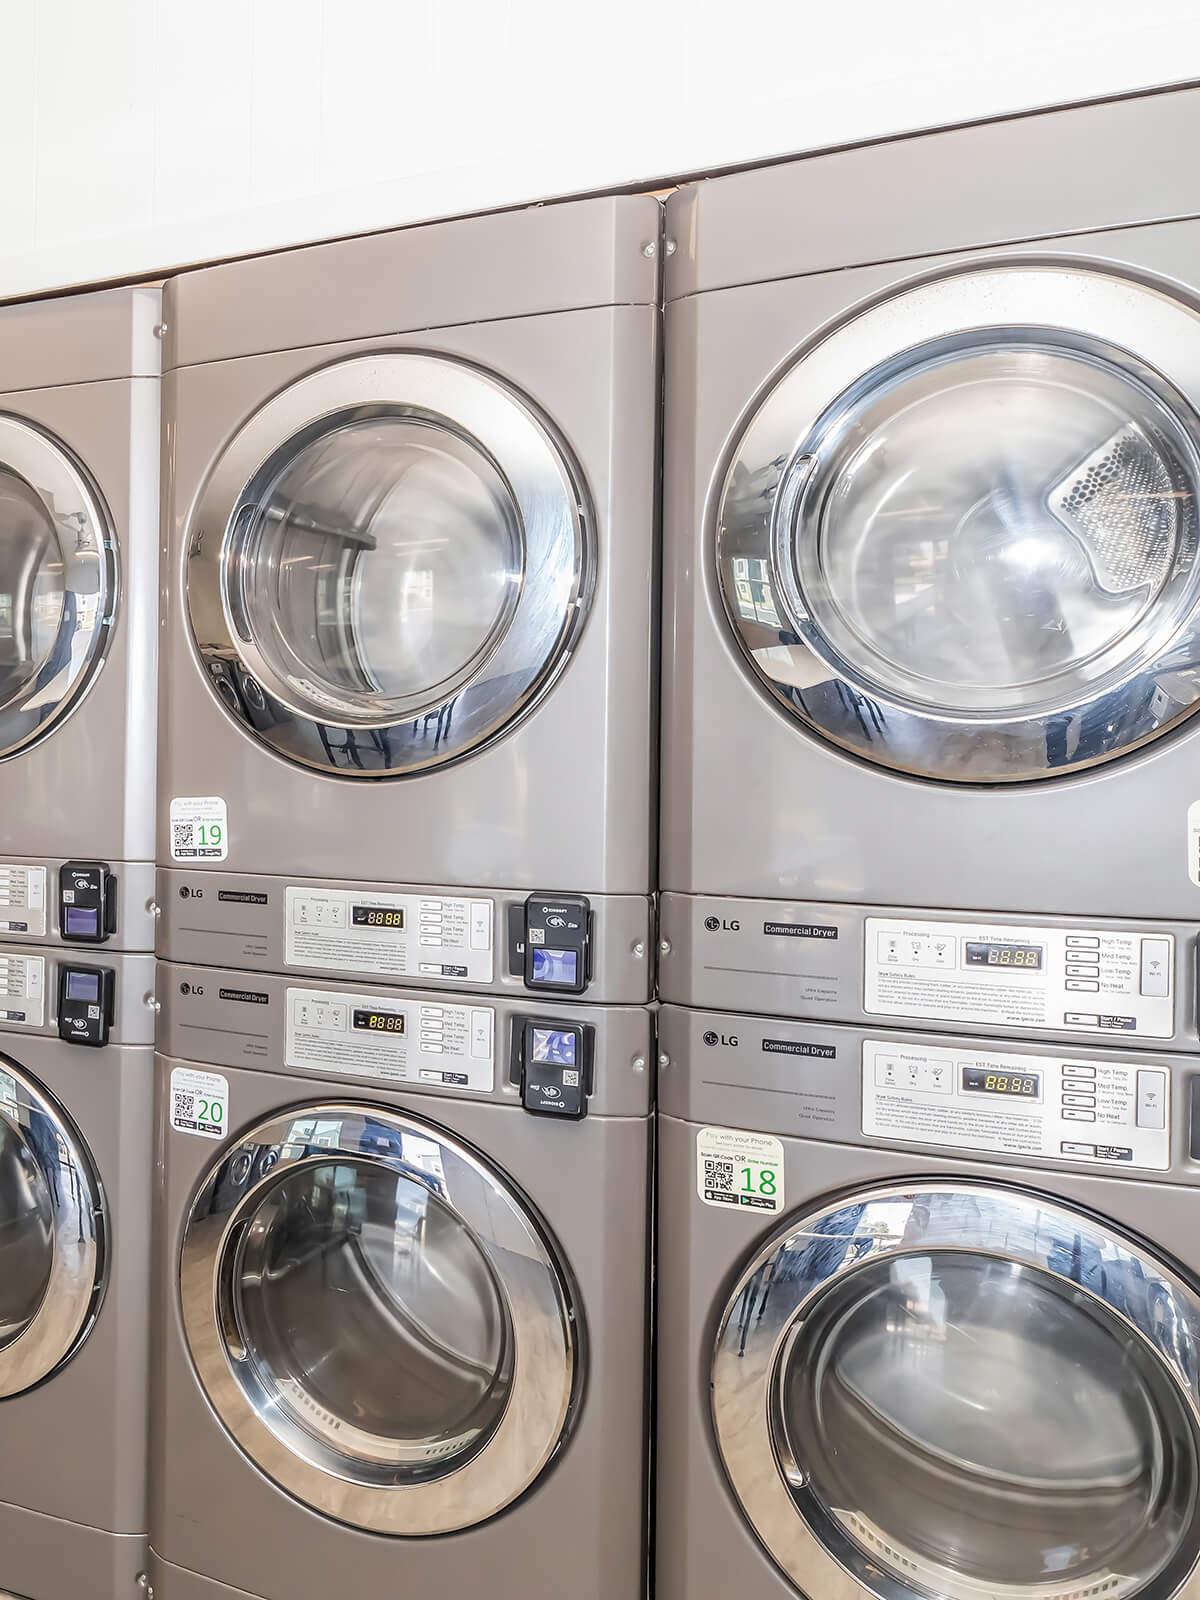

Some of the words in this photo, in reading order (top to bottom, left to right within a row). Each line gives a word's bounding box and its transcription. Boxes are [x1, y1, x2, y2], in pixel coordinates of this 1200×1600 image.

[198, 825, 222, 846] 19
[191, 889, 204, 898] LG
[723, 919, 740, 931] LG
[765, 924, 811, 936] Commercial
[812, 926, 836, 937] Dryer
[192, 985, 204, 996] LG
[721, 1035, 738, 1046] LG
[763, 1041, 810, 1054] Commercial
[811, 1044, 834, 1057] Dryer
[198, 1099, 223, 1123] 20
[751, 1137, 773, 1146] Phone
[734, 1155, 746, 1163] OR
[741, 1167, 777, 1196] 18
